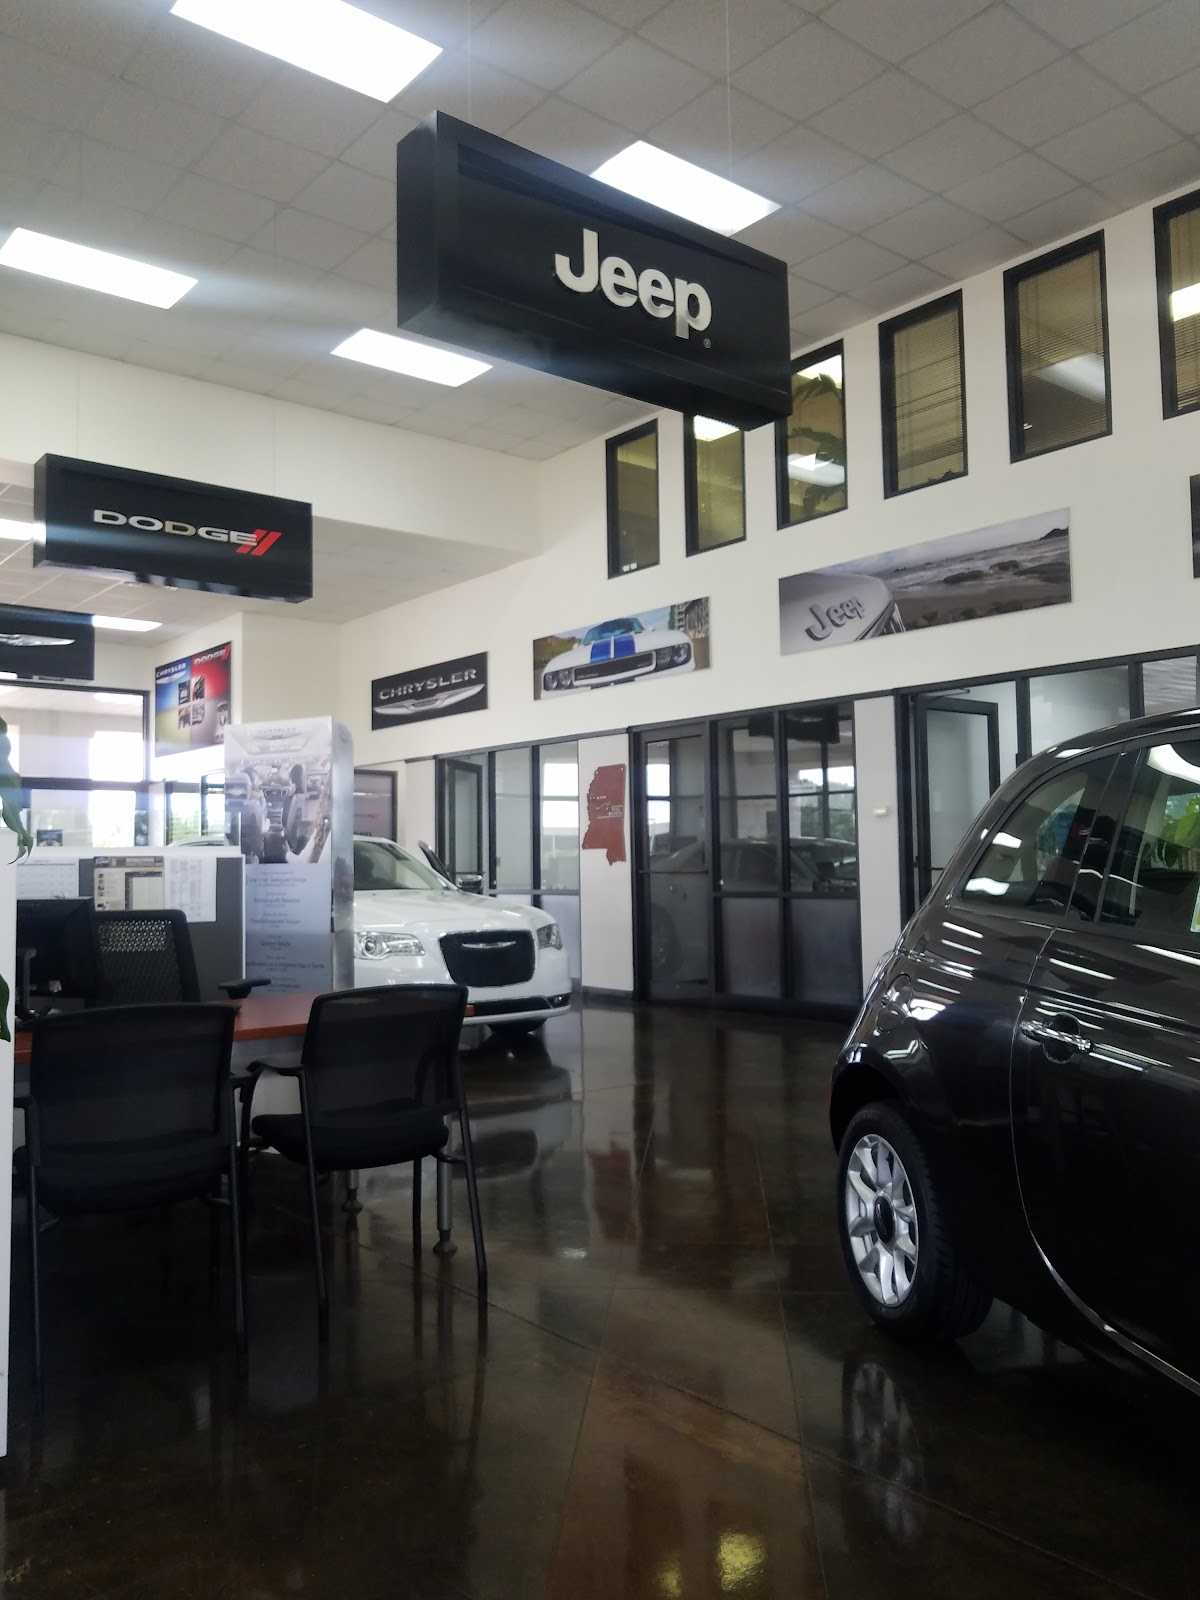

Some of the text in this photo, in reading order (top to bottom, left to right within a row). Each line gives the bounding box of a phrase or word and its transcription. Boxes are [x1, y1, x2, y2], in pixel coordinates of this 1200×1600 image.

[552, 228, 713, 339] Jeep
[93, 509, 257, 546] DODGE
[804, 596, 866, 641] Jeep
[156, 662, 187, 678] CHRYSLER
[379, 668, 477, 700] CHRYSLER
